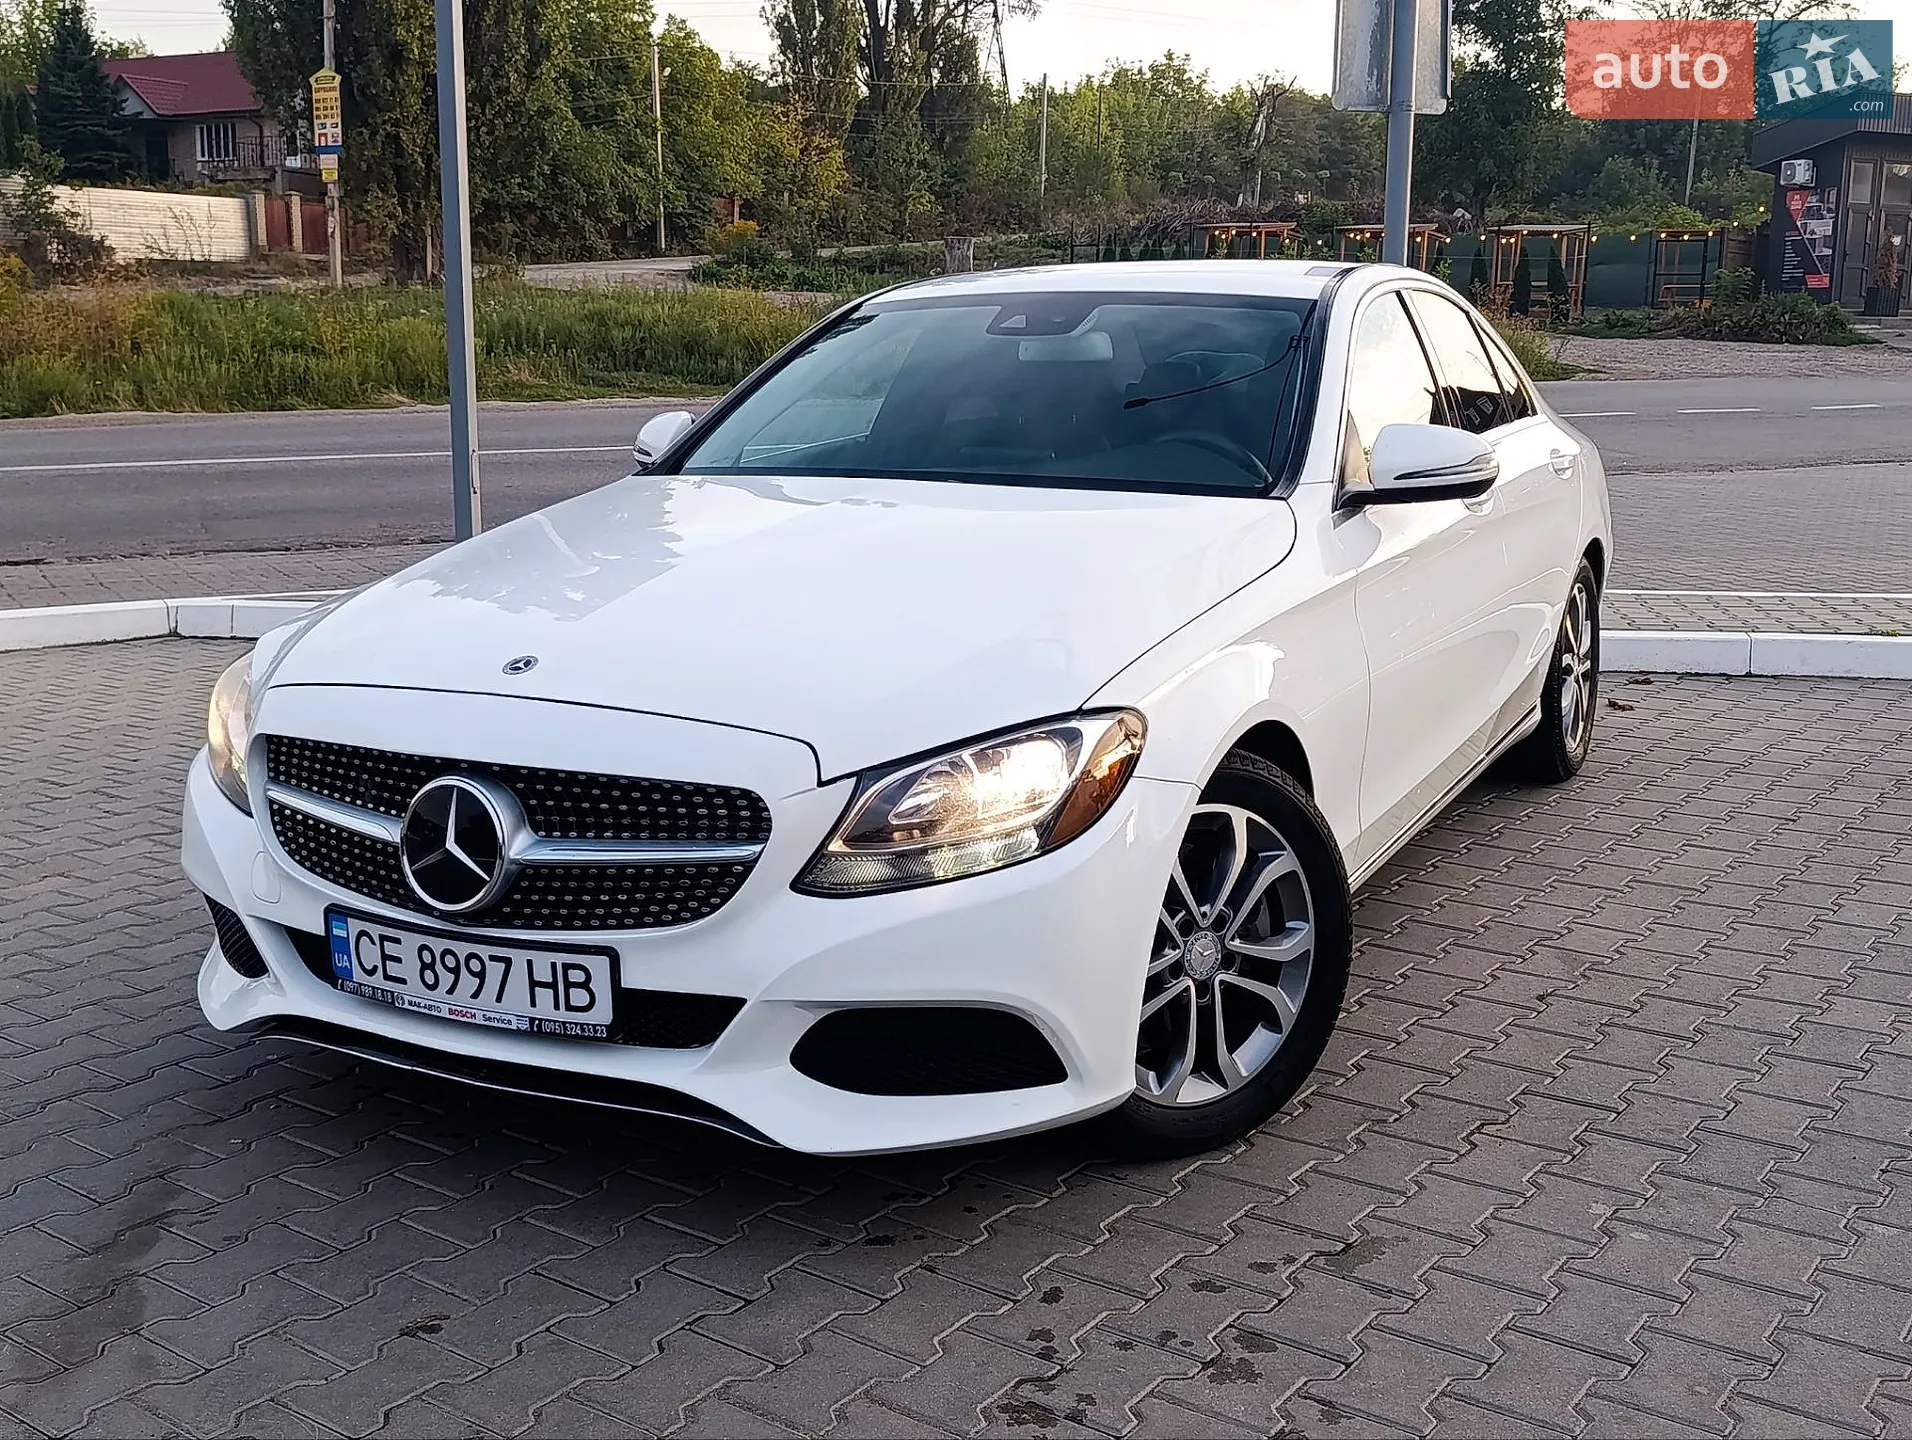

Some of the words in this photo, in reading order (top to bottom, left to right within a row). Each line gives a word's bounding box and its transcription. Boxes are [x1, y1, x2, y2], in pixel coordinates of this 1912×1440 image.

[335, 953, 350, 968] UA
[354, 929, 407, 985] CE
[417, 944, 513, 1004] 8997
[526, 958, 596, 1013] HB
[448, 1007, 477, 1020] BOSCH
[482, 1013, 513, 1026] Service
[542, 1021, 564, 1035] (095)
[565, 1023, 607, 1038] 324.33.23
